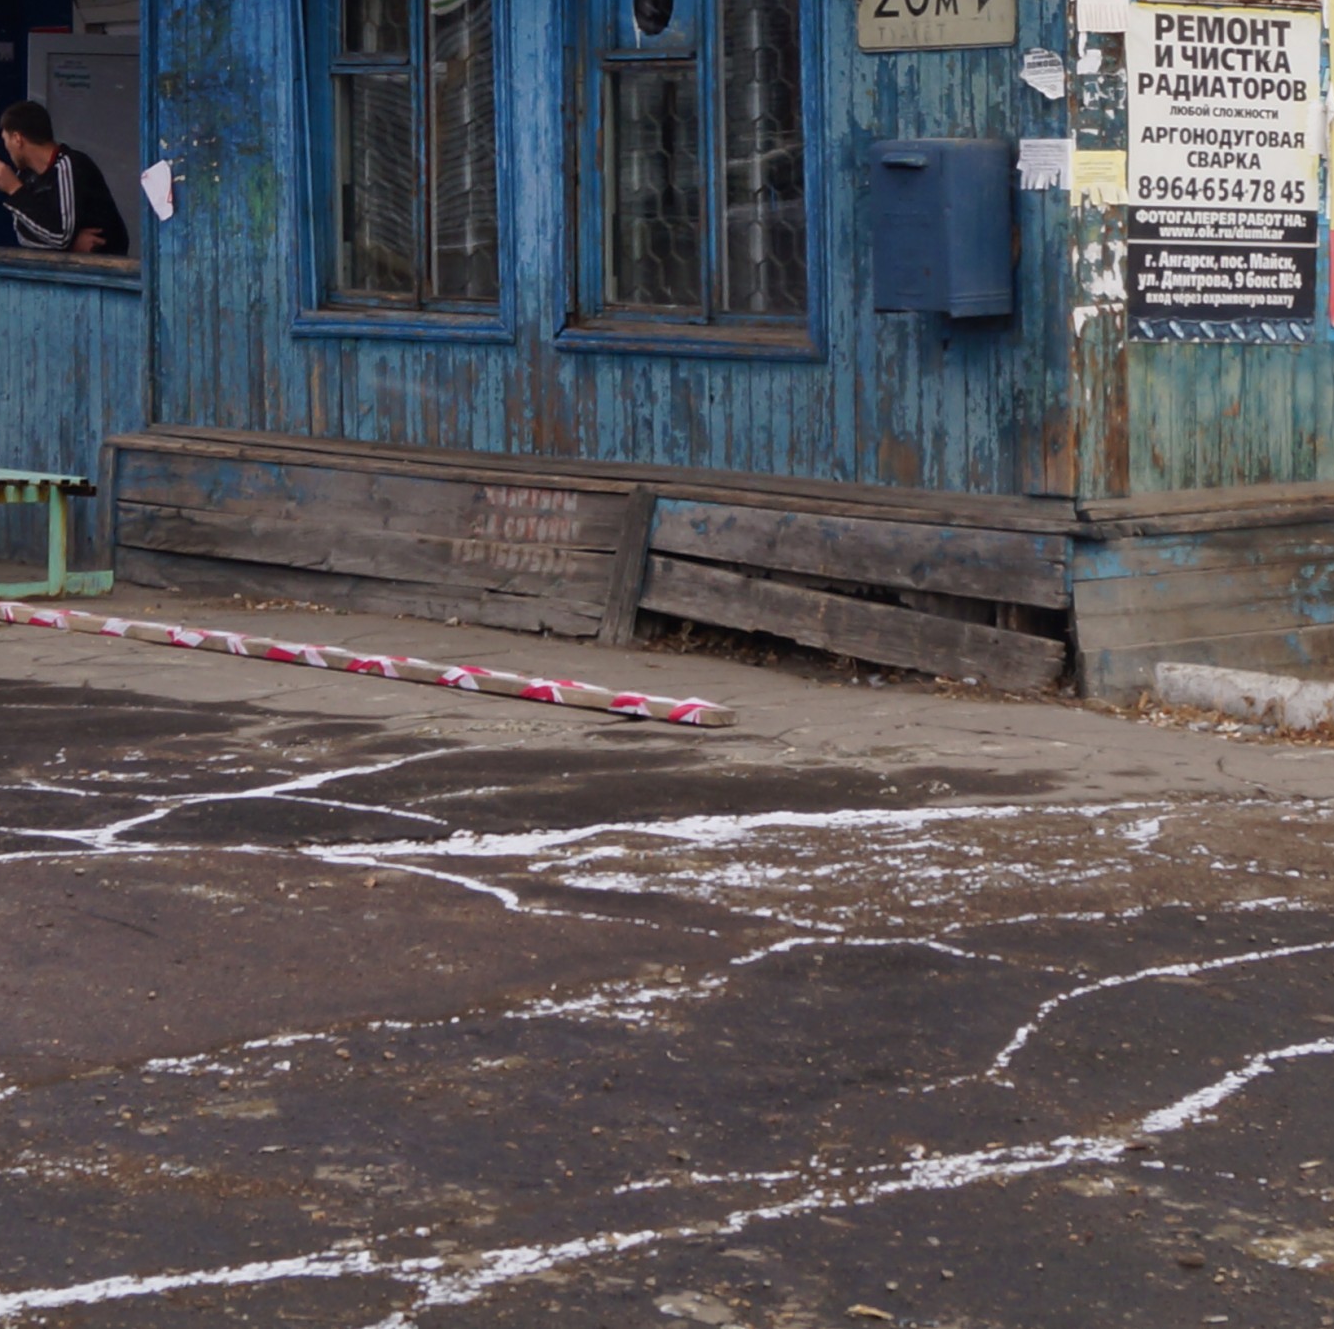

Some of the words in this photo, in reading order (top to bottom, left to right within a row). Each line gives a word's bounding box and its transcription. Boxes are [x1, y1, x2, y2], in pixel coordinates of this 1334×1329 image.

[1155, 13, 1291, 47] РЕМОНТ
[1155, 44, 1174, 68] И
[1181, 45, 1291, 74] ЧИСТКА
[1137, 73, 1307, 101] РАДИАТОРОВ
[1170, 104, 1210, 117] ЛЮБОЙ
[1212, 107, 1279, 120] СЛОЖНОСТИ
[1141, 126, 1305, 149] АРГОНОДУГОВАЯ
[1187, 150, 1261, 170] СВАРКА
[1280, 179, 1305, 204] 45
[1135, 209, 1237, 225] ФОТОГАЛЕРЕЯ
[1238, 213, 1282, 227] РАБОТ
[1283, 214, 1307, 228] НА:
[1159, 225, 1285, 241] www.ok.ru/dumkar
[1145, 253, 1157, 268] г.
[1158, 250, 1218, 272] Ангарск,
[1220, 256, 1248, 269] пос.
[1249, 252, 1297, 272] Майск,
[1137, 273, 1159, 291] ул.
[1161, 271, 1233, 291] Дмитрова,
[1235, 273, 1244, 288] 9
[1245, 271, 1277, 288] бокс
[1279, 272, 1303, 290] №4
[1145, 292, 1171, 306] вход
[1172, 293, 1202, 308] через
[1266, 294, 1295, 309] вахту
